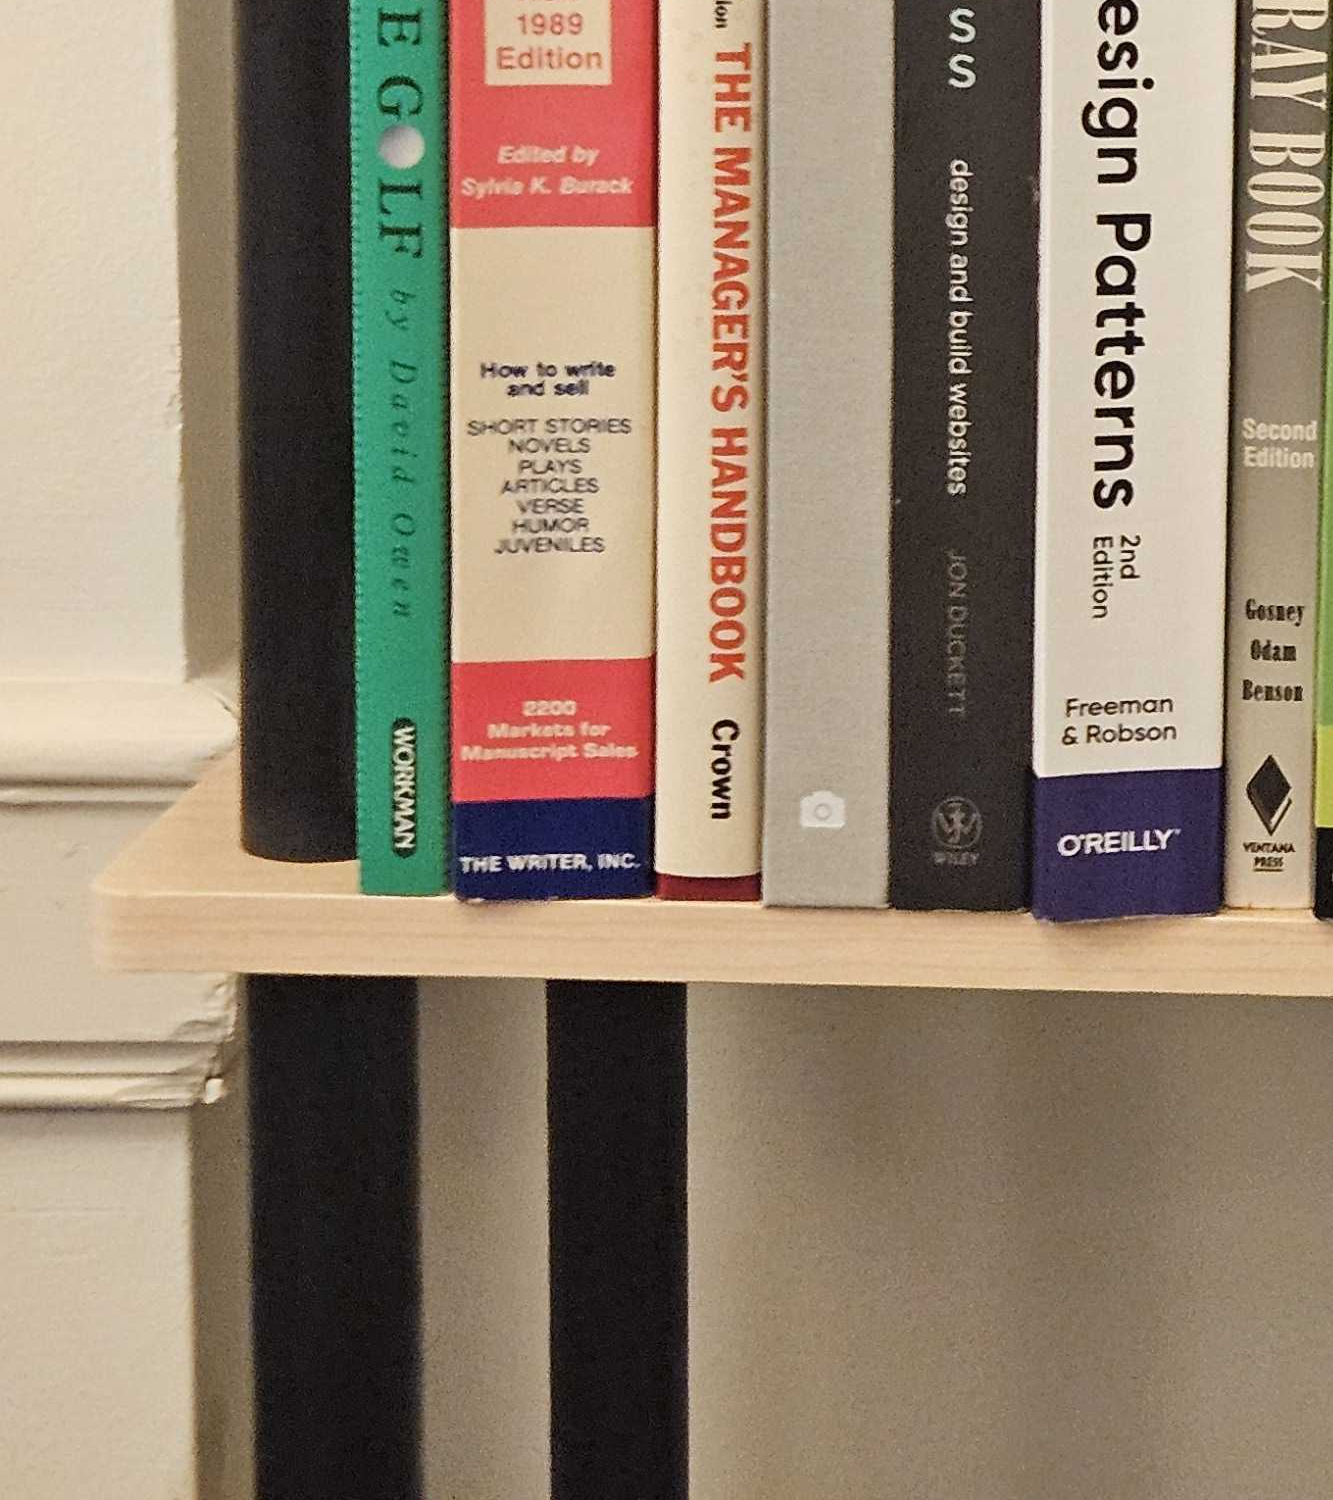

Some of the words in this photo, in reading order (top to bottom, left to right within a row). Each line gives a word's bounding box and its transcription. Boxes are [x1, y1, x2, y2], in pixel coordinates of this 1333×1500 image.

[518, 13, 582, 35] 1989
[496, 46, 601, 70] Edition
[715, 42, 752, 132] THE
[945, 159, 973, 245] design
[1246, 130, 1325, 292] BOOK
[712, 148, 752, 412] MANAGER'S
[949, 253, 973, 301] and
[948, 311, 973, 374] build
[1093, 214, 1151, 508] Patterns
[467, 419, 538, 436] SHORT
[545, 418, 631, 434] STORIES
[948, 383, 972, 495] websites
[509, 438, 590, 453] NOVELS
[519, 459, 582, 474] PLAYS
[501, 478, 599, 494] ARTICLES
[518, 498, 583, 514] VERSE
[512, 518, 589, 534] HUMOR
[494, 537, 605, 554] JUVENILES
[710, 428, 748, 682] HANDBOOK
[1120, 535, 1140, 579] 2nd
[1093, 537, 1113, 618] Edition
[1066, 698, 1173, 717] Freeman
[1062, 726, 1077, 745] &
[1086, 724, 1176, 743] Robson
[711, 720, 740, 819] Crown
[1057, 828, 1172, 857] O'REILLY
